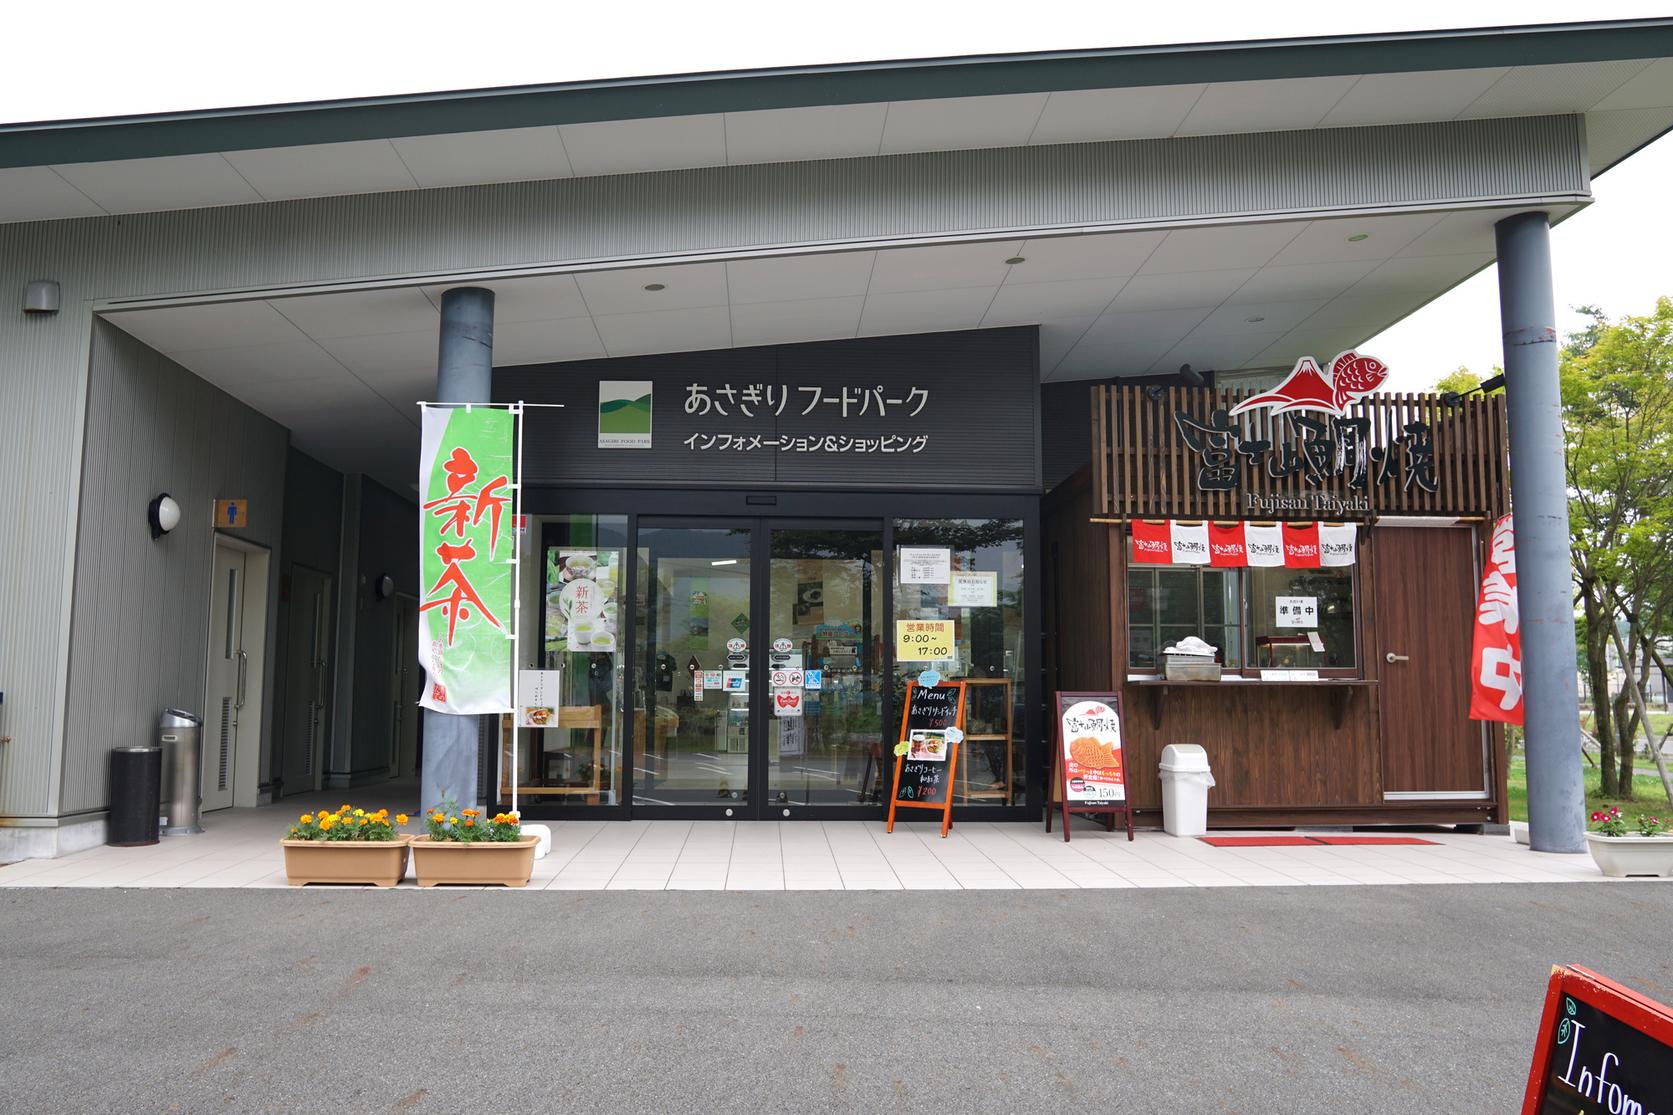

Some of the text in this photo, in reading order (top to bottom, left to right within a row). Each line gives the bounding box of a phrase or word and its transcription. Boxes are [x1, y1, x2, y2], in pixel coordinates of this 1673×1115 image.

[684, 383, 929, 418] あさぎり フードパーク
[683, 432, 929, 454] インフォメーション&ショッピング
[1246, 493, 1370, 515] Fujisan Taiyaki
[419, 447, 512, 648] 新茶
[575, 585, 589, 615] 新茶
[1279, 605, 1314, 616] 準備中
[906, 623, 945, 632] 営業時間
[918, 647, 948, 656] 17:00
[917, 688, 946, 700] Menu
[1557, 1019, 1657, 1115] Infom
